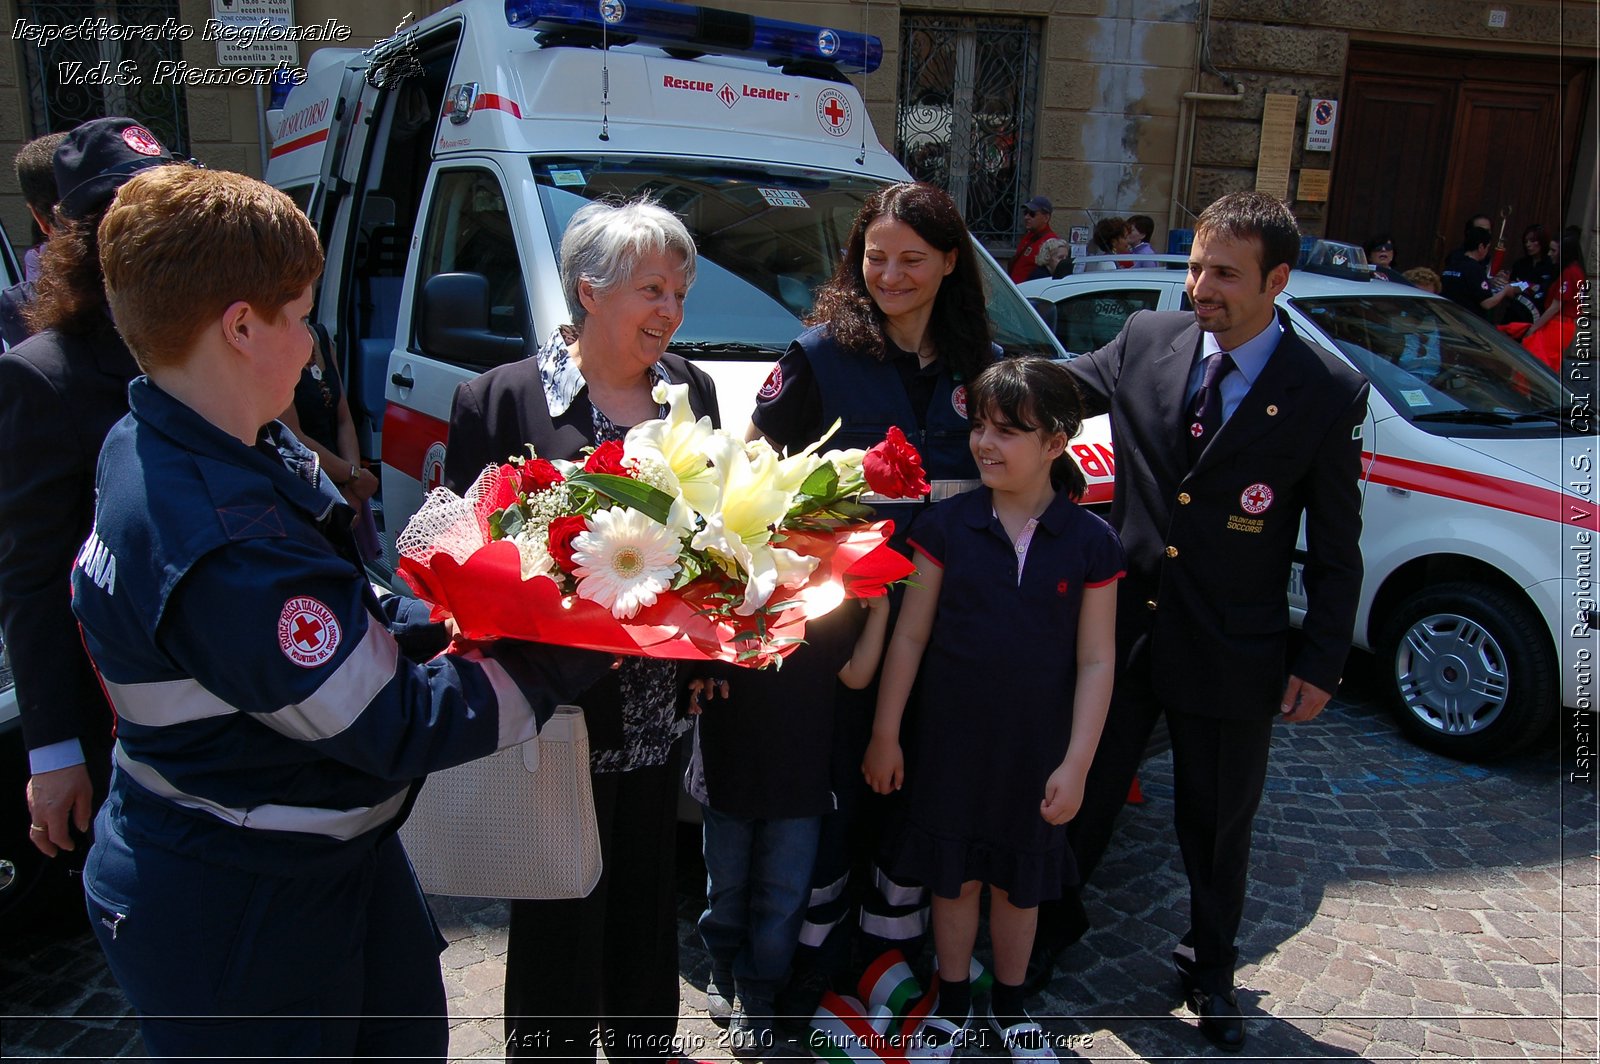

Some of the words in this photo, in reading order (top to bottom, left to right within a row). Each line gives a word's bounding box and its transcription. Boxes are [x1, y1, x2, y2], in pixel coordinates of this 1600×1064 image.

[252, 43, 288, 51] massima
[223, 53, 266, 61] consentita
[663, 75, 714, 93] Rescue
[742, 84, 790, 102] Leader
[828, 126, 845, 134] ASTI
[1227, 521, 1263, 533] SOCCORSO
[282, 600, 302, 623] ROSSA
[301, 599, 333, 624] ITALIANA
[280, 620, 293, 650] CROCE
